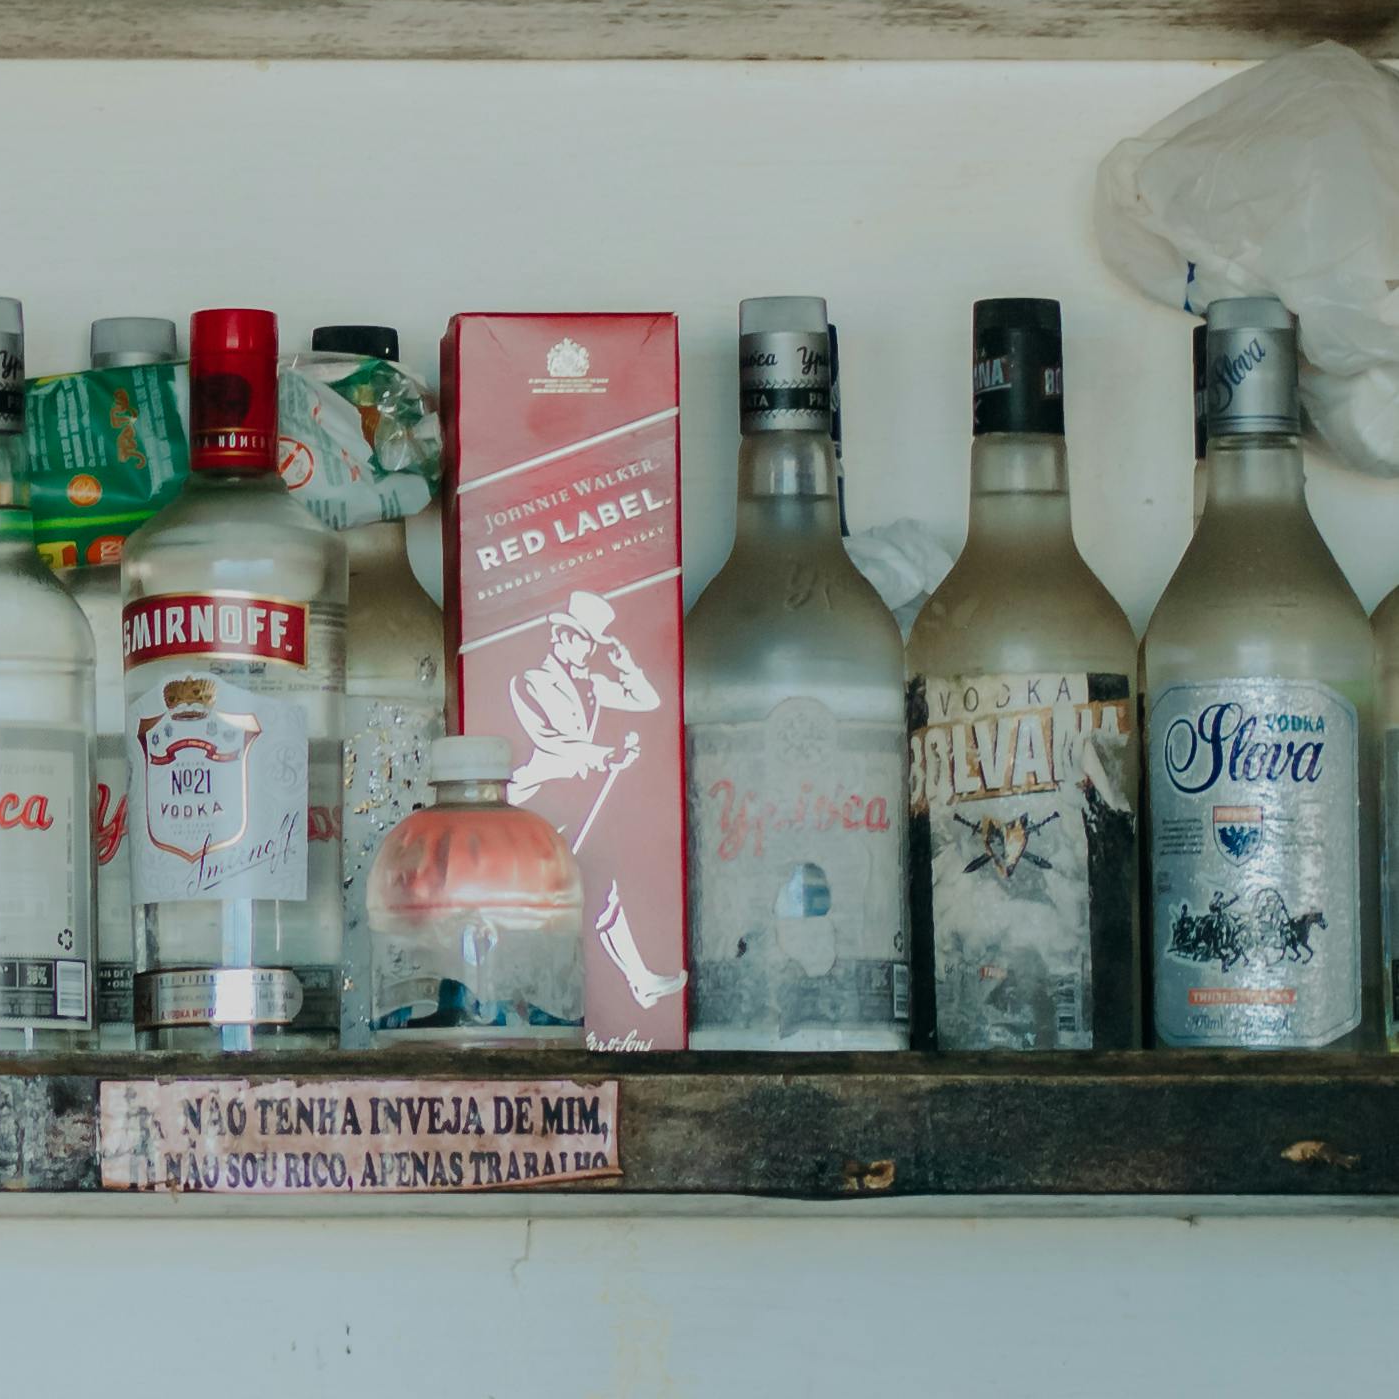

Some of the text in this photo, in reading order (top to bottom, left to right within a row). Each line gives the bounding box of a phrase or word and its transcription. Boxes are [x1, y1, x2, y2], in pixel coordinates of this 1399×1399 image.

[475, 487, 665, 572] RED LABEL
[484, 458, 654, 536] JOHNNIE WALKER
[477, 524, 666, 601] BLENDED SCOTCH WHISKY
[1165, 702, 1325, 793] Slova
[1265, 714, 1325, 733] VODKA
[161, 802, 225, 820] VODKA
[181, 1088, 609, 1143] NÃO TENHA INVEJA DE MIM,
[164, 1139, 219, 1189] NÃO
[225, 1149, 278, 1189] SOU
[285, 1149, 355, 1192] RICO,
[360, 1149, 463, 1188] APENAS
